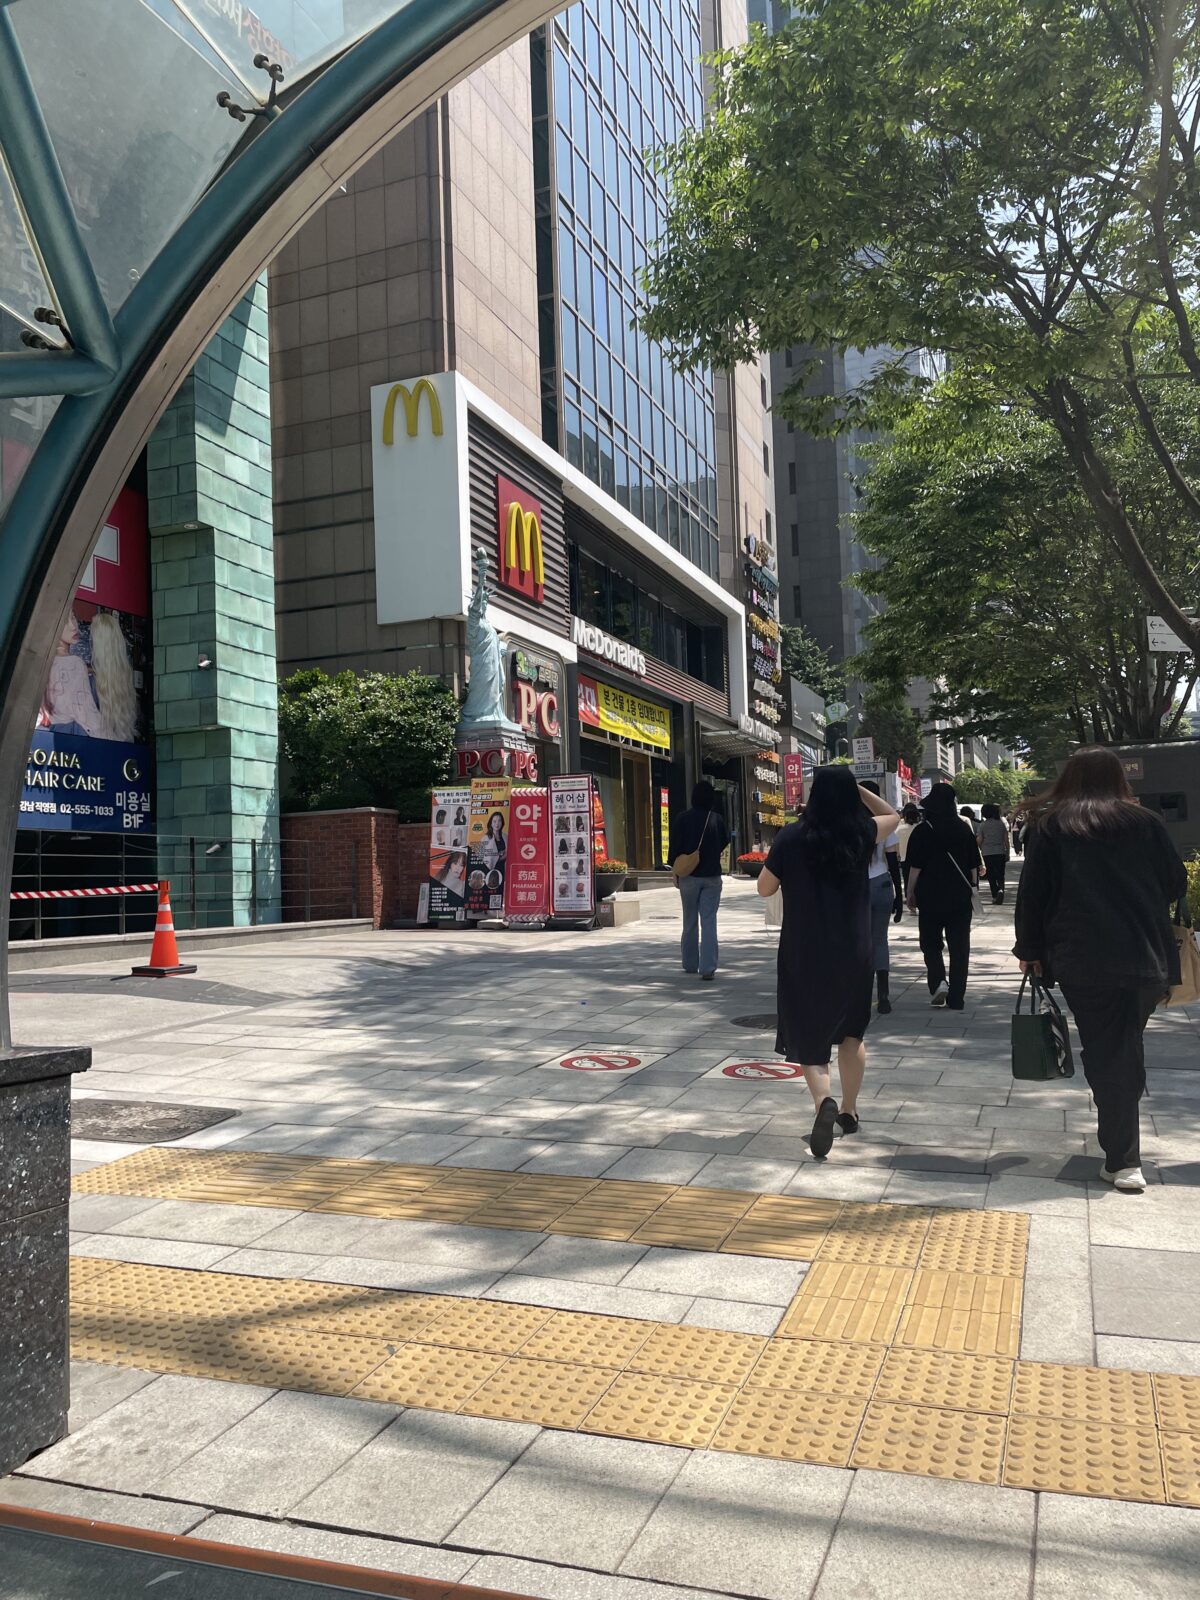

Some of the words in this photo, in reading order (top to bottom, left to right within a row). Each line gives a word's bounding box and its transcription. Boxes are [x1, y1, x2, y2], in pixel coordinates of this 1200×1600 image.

[572, 615, 647, 676] McDonald's
[515, 681, 559, 737] PC
[603, 687, 611, 707] 본
[612, 692, 625, 712] 건물
[626, 698, 637, 716] 1층
[456, 749, 505, 779] PC
[514, 750, 538, 782] PC
[787, 764, 800, 776] 약
[62, 773, 106, 793] CARE
[115, 791, 151, 812] 미용실
[555, 793, 587, 804] 헤어샵
[60, 803, 114, 816] 02-555-1033
[515, 804, 542, 834] 약
[123, 813, 144, 829] B1F
[517, 870, 538, 881] 药店
